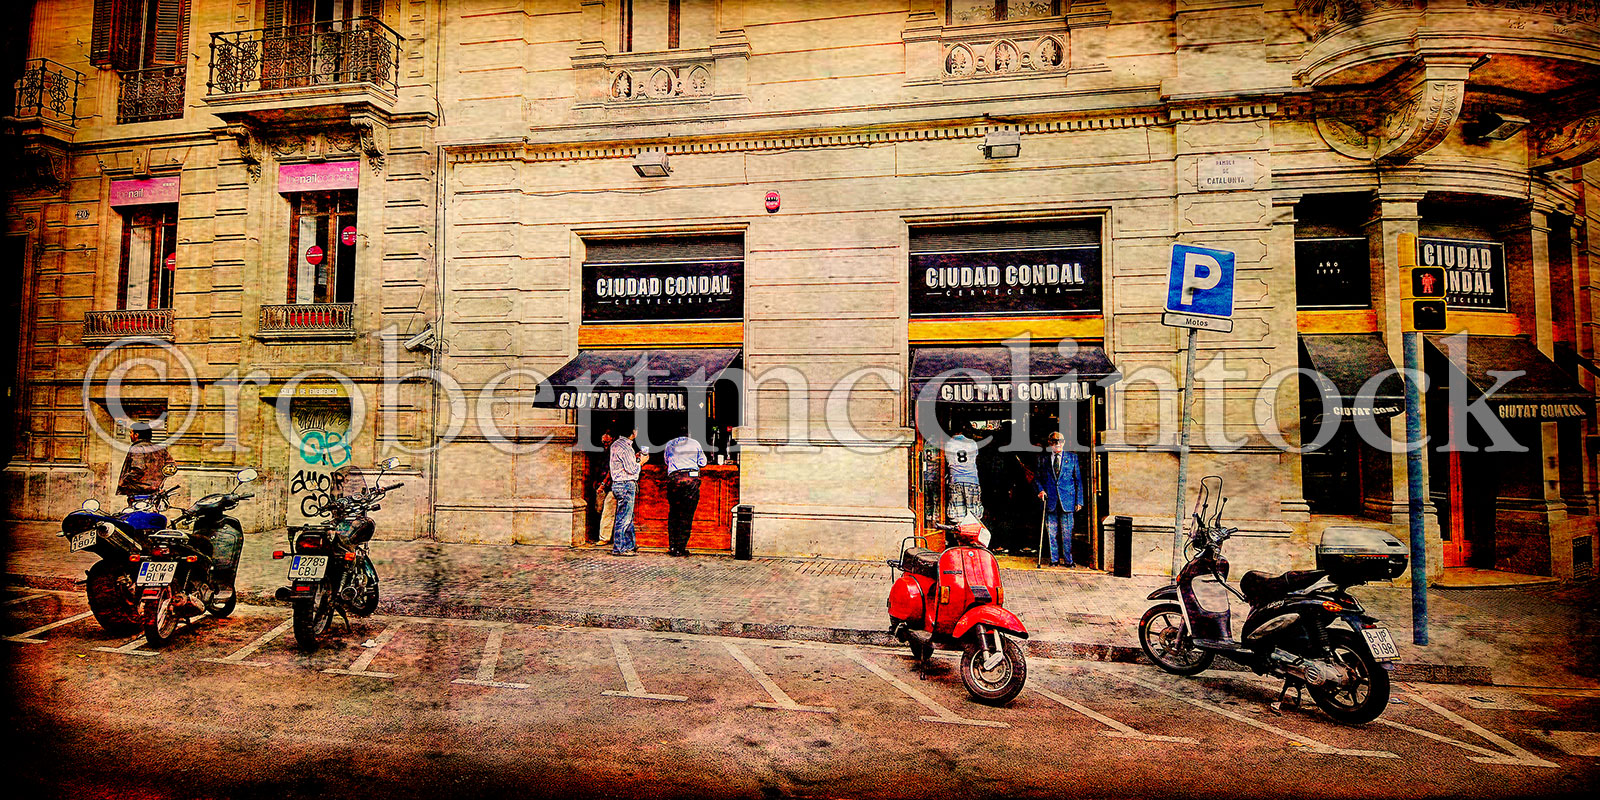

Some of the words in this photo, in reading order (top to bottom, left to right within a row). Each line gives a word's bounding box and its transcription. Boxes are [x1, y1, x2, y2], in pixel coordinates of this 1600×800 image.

[1207, 177, 1245, 185] CATALUNYA
[1424, 244, 1492, 271] CIUDAD
[925, 266, 1000, 289] CIUDAD
[1005, 263, 1085, 287] CONDAL
[1181, 252, 1222, 305] P
[1445, 270, 1494, 296] NDAL
[596, 278, 662, 298] CIUDAD
[665, 275, 732, 296] CONDAL
[946, 287, 1061, 297] CERVECERIA
[615, 297, 713, 305] CERVECERIA
[1185, 318, 1209, 327] Motos
[941, 384, 1012, 402] CIUTAT
[1017, 382, 1091, 401] COMTAL
[559, 392, 620, 409] CIUTAT
[624, 392, 686, 410] COMTAL
[1333, 402, 1371, 416] CIUTAT
[1498, 404, 1538, 419] CIUTAT
[1540, 404, 1587, 417] COMTAL
[956, 449, 968, 463] 8
[73, 537, 95, 549] 1807
[148, 564, 175, 573] 3048
[300, 557, 326, 566] 2789
[298, 567, 318, 576] CBJ
[1365, 631, 1387, 643] B-UP
[1372, 642, 1395, 656] 6198
